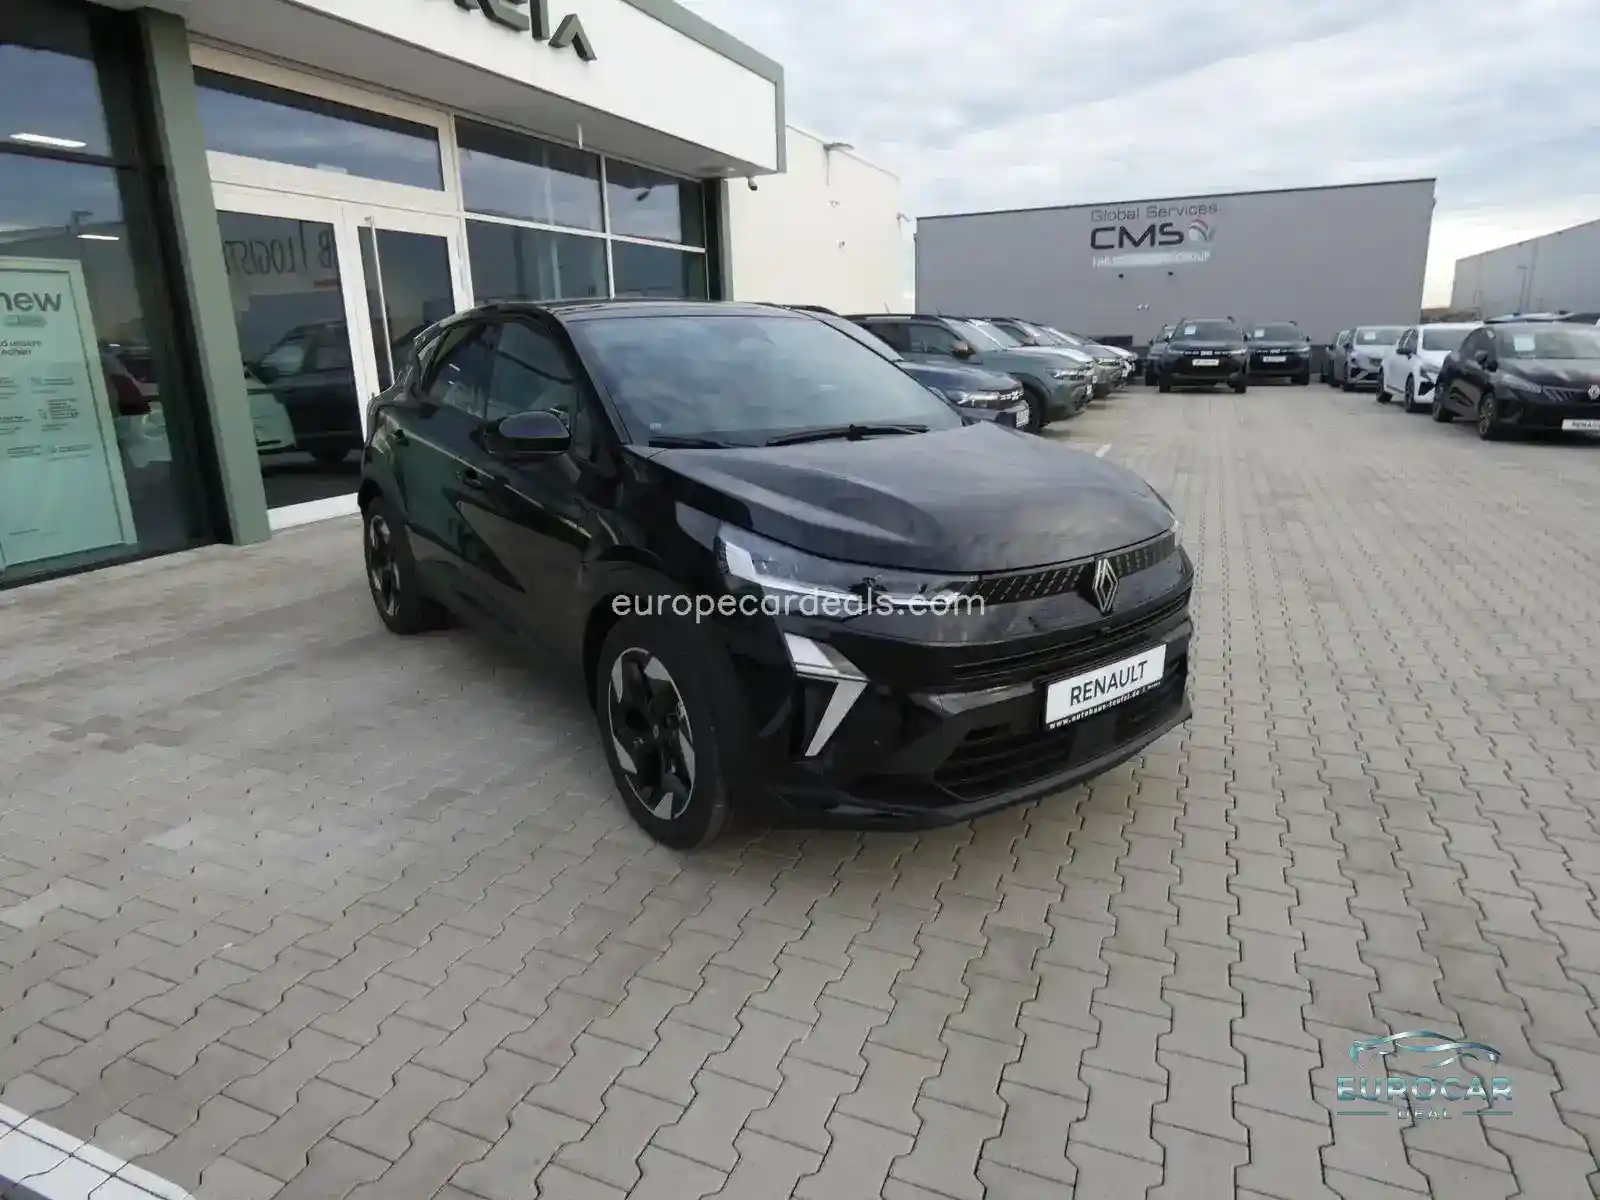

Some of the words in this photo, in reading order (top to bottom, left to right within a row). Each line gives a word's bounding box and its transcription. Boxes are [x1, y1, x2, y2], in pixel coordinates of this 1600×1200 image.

[1091, 208, 1139, 222] Global
[1146, 203, 1218, 219] Services
[1090, 222, 1184, 250] CMS
[1069, 659, 1148, 707] RENAULT
